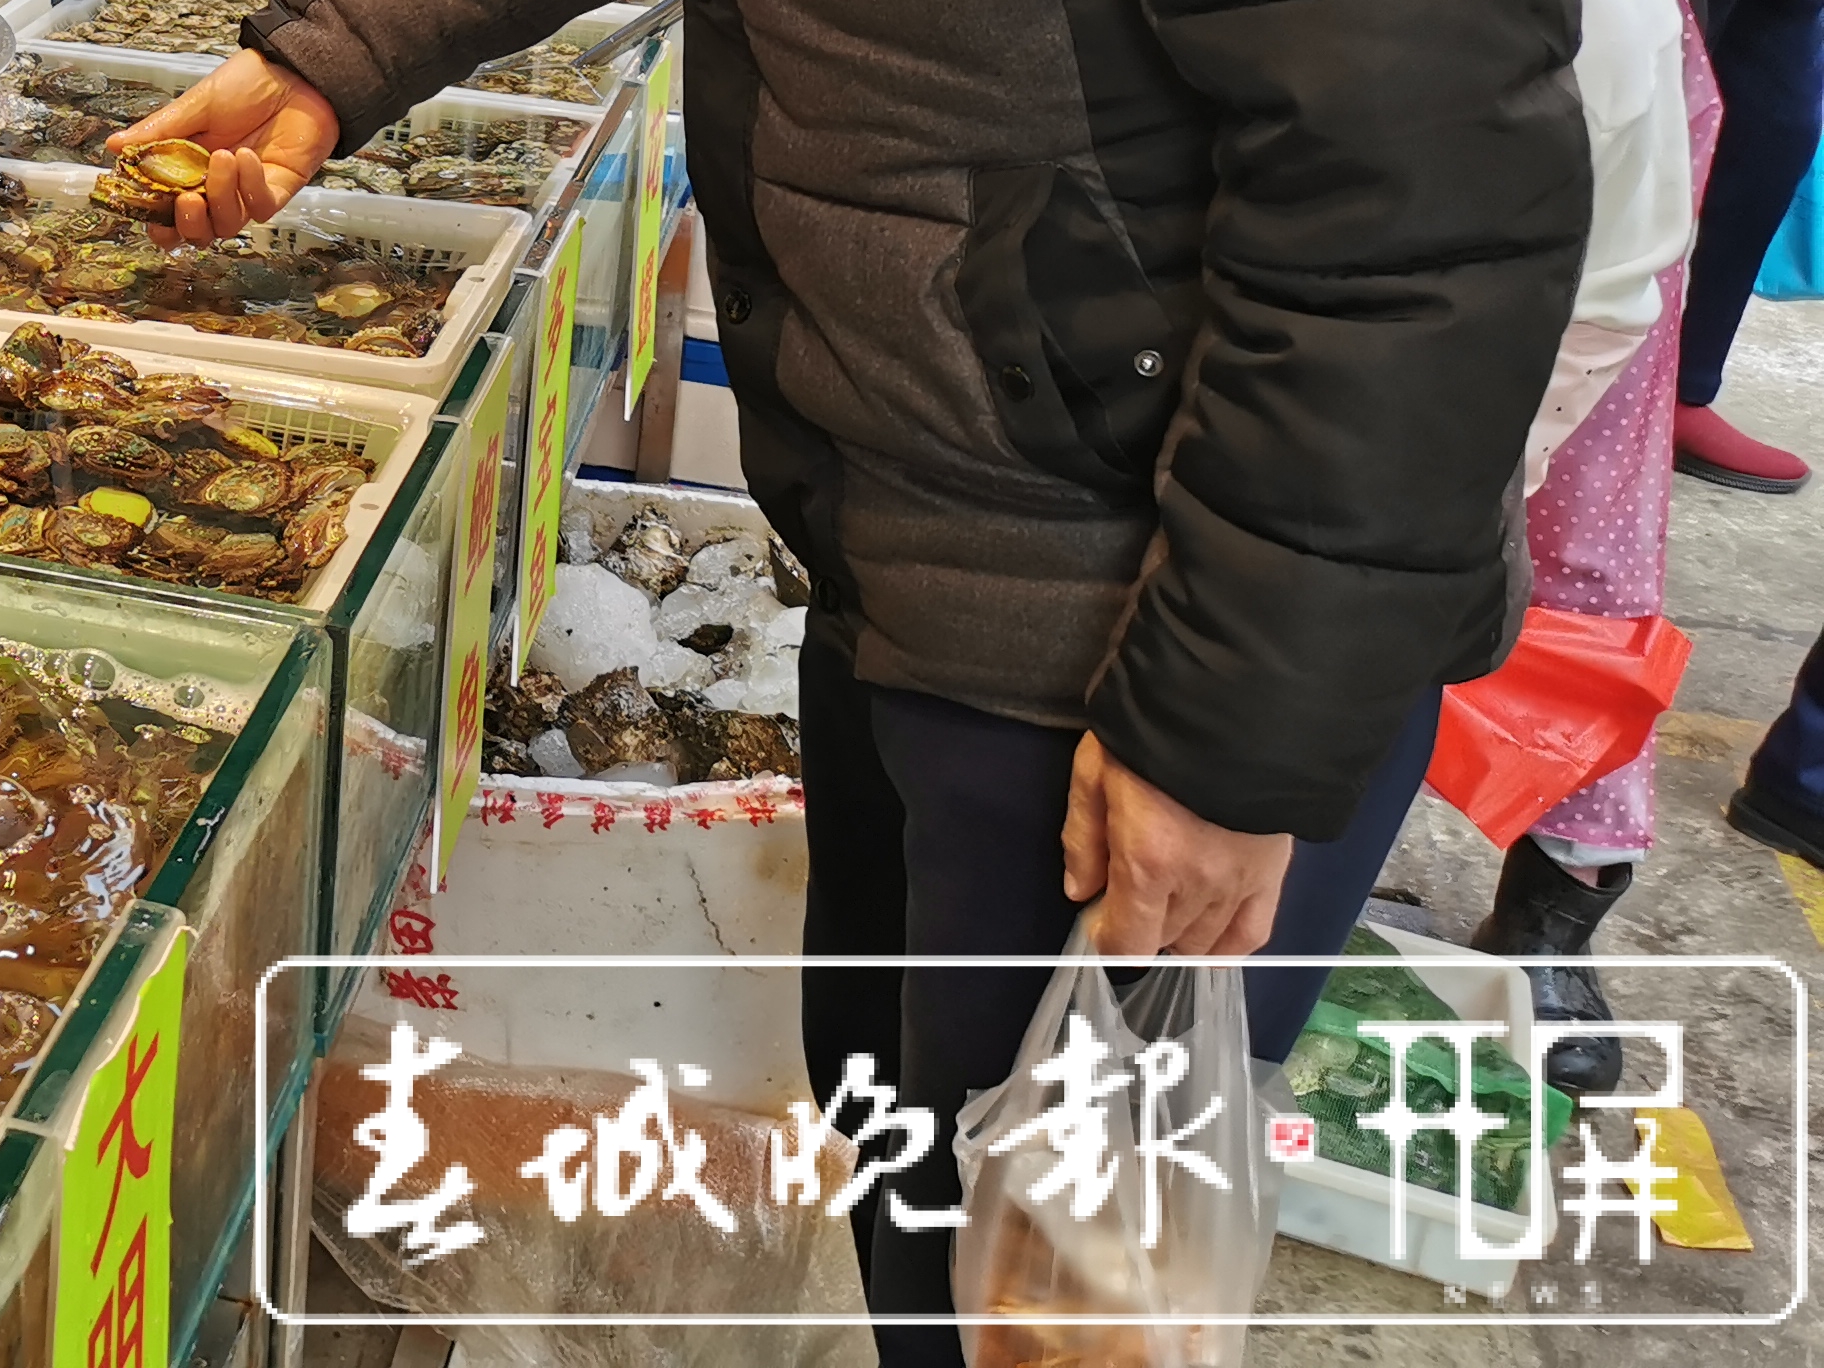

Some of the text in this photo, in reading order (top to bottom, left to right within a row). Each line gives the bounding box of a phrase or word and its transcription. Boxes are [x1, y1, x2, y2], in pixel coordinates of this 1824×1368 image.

[451, 430, 500, 801] 鲍鱼
[525, 265, 568, 642] 多宝鱼
